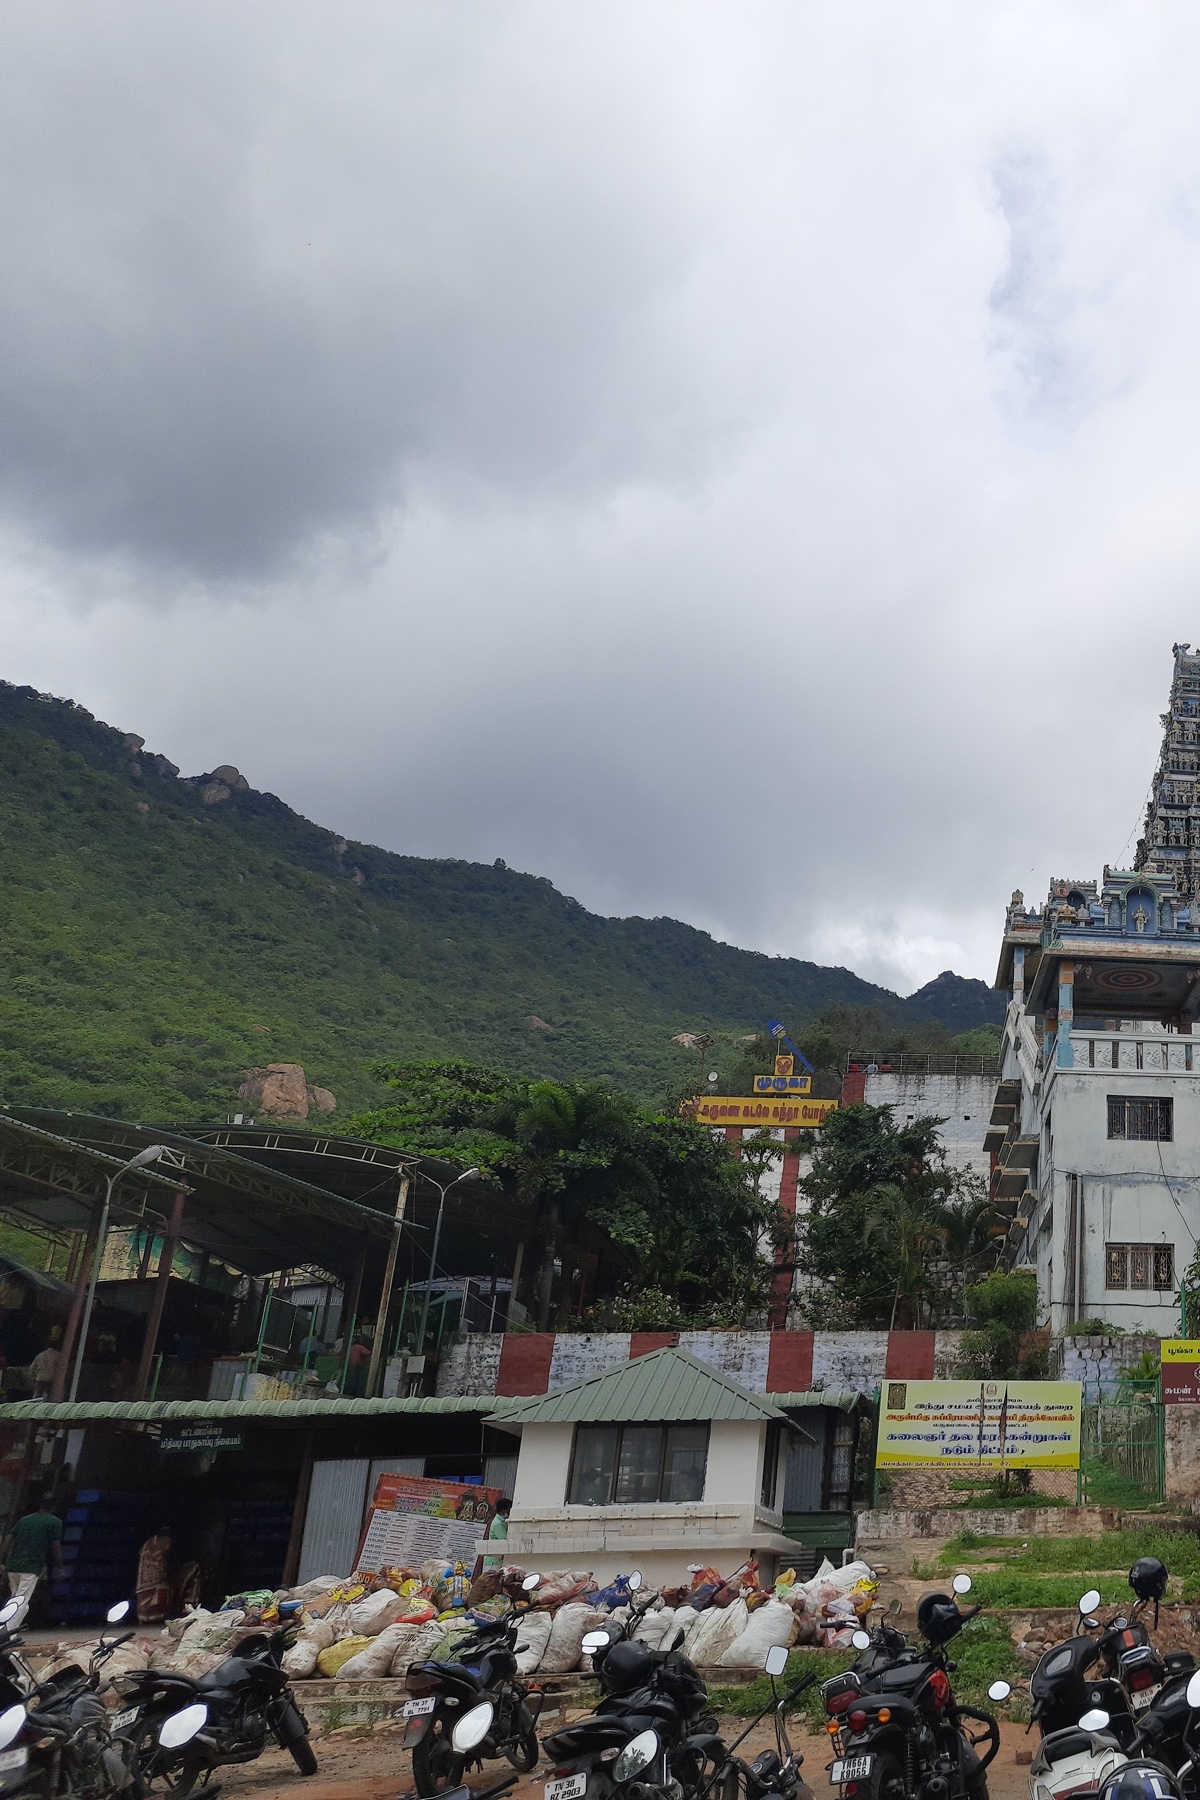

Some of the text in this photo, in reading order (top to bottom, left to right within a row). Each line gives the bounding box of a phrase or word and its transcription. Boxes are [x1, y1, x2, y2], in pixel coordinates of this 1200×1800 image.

[757, 1077, 808, 1091] முருகா
[743, 1103, 769, 1118] கடலே
[773, 1102, 799, 1122] கந்தா
[1168, 1347, 1193, 1356] பூங்கா
[1164, 1384, 1192, 1395] சுமன்
[914, 1402, 944, 1411] இந்து
[1044, 1404, 1074, 1412] துறை
[886, 1414, 930, 1422] அருள்மிகு
[886, 1431, 946, 1441] கலைஞர்
[949, 1433, 973, 1441] தல
[940, 1443, 974, 1455] நடும்
[842, 1757, 867, 1770] TN66A
[554, 1779, 575, 1791] TN 38
[561, 1787, 581, 1799] 2903
